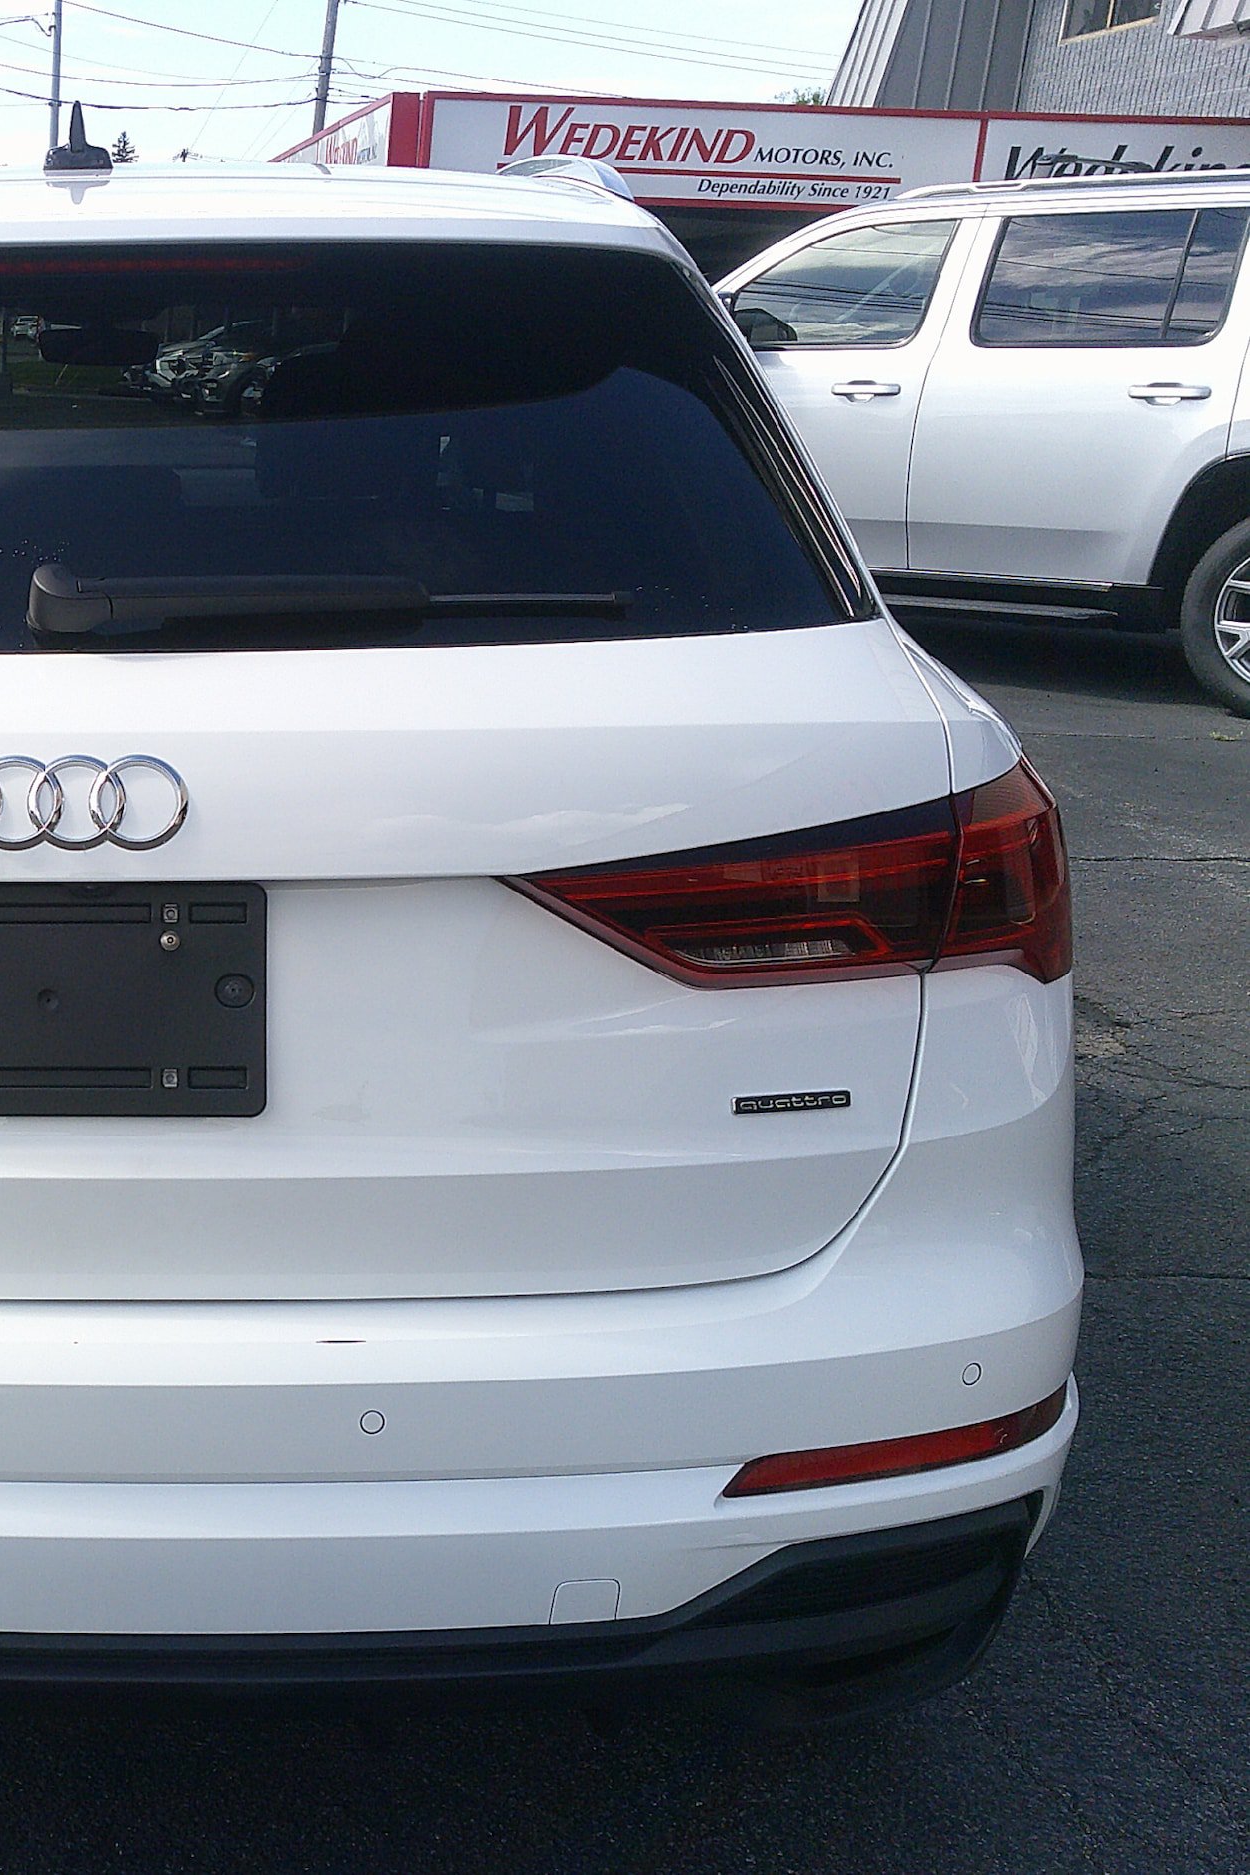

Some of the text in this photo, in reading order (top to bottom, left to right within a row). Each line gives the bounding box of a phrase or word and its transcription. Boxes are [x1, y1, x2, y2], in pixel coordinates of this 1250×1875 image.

[502, 104, 894, 170] WEDEKIND MOTORS, INC.
[696, 178, 891, 201] Dependability Since 1921
[739, 1094, 847, 1111] quattro
